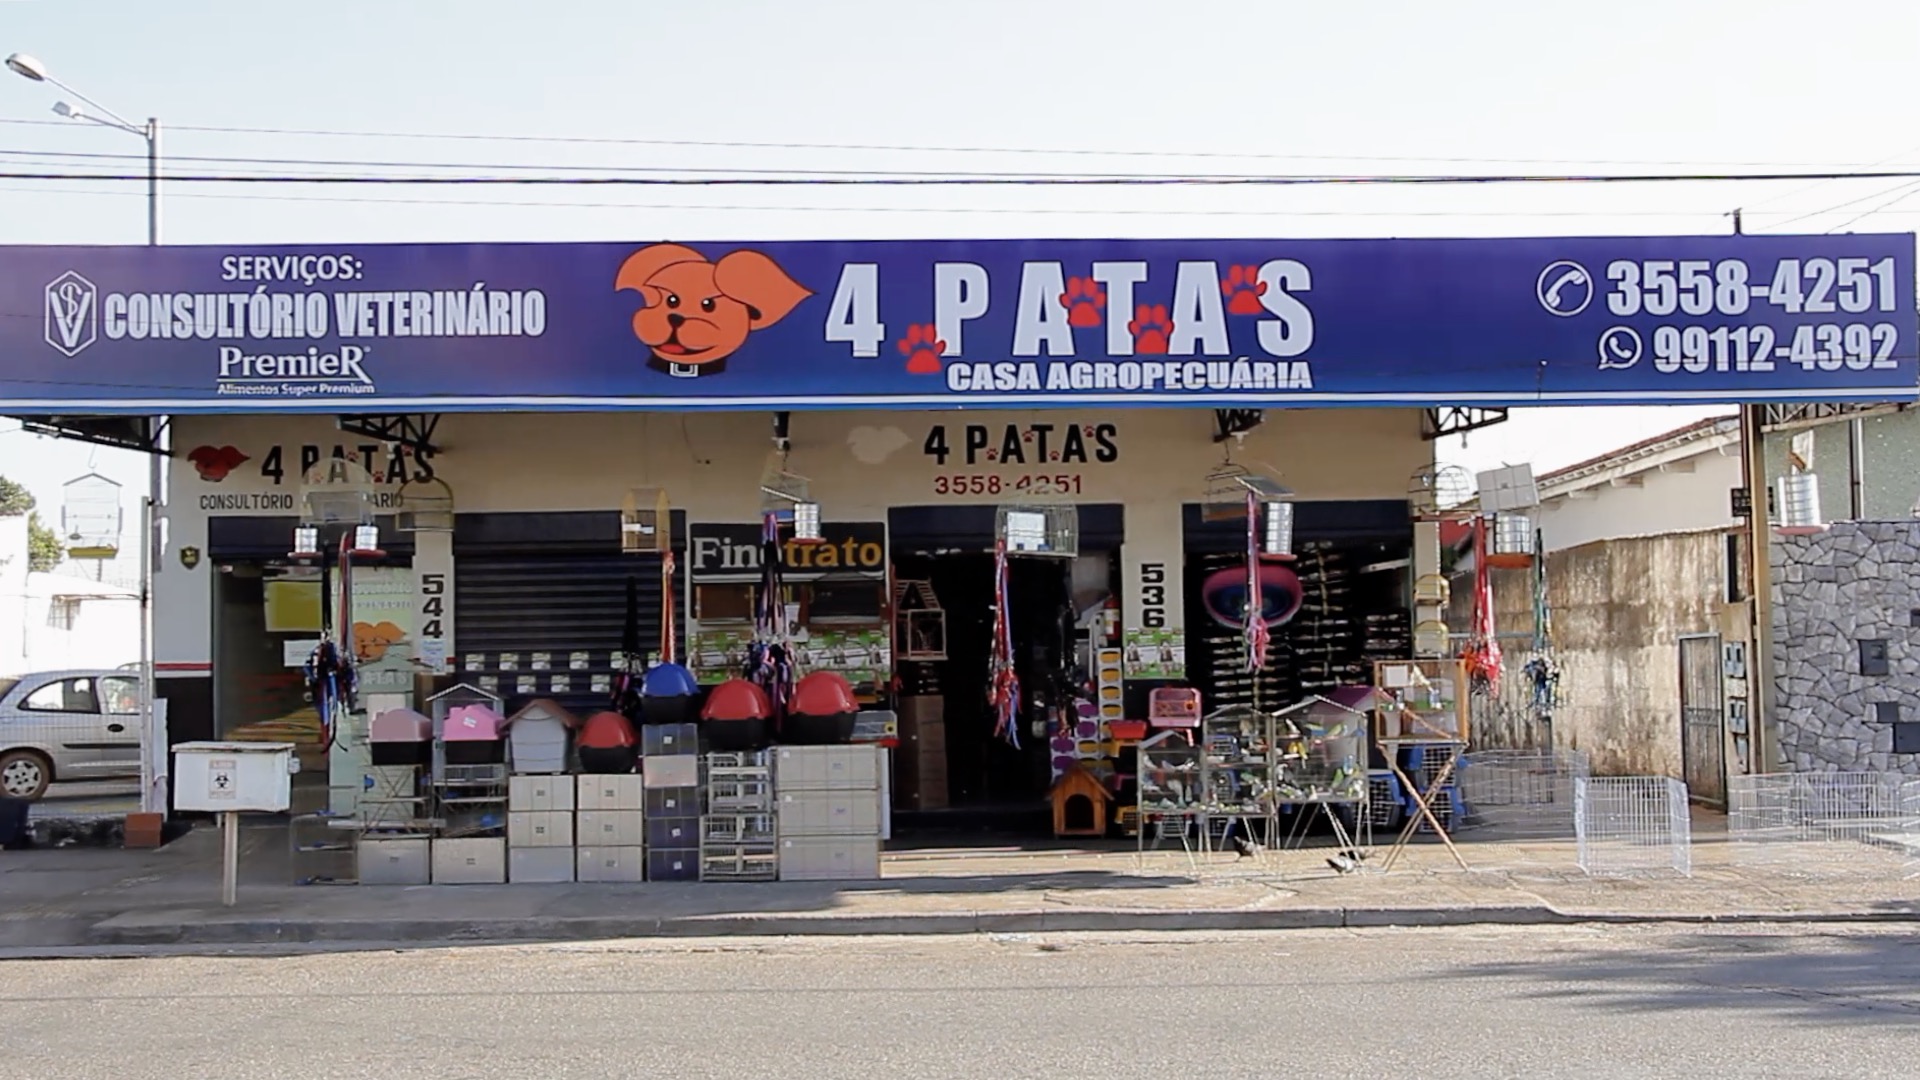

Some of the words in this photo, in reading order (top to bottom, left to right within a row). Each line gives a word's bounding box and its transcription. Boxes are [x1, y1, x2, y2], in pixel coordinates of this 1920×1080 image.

[222, 255, 363, 285] SERVIÇOS:
[1607, 257, 1896, 316] 3558-4251
[105, 285, 328, 339] CONSULTÓRIO
[335, 282, 546, 337] VETERINÁRIO
[824, 263, 886, 357] 4
[933, 260, 1314, 357] PATAS
[1653, 323, 1898, 373] 99112-4392
[217, 383, 279, 395] Alimentos
[281, 383, 317, 397] Super
[319, 381, 375, 394] Premium
[948, 361, 1039, 391] CASA
[1046, 356, 1313, 390] AGROPECUÁRIA
[261, 445, 283, 484] 4
[924, 425, 949, 465] 4
[966, 424, 1118, 464] PATAS
[200, 491, 293, 510] CONSULTÓRIO
[422, 574, 444, 638] 544
[1141, 563, 1165, 628] 536
